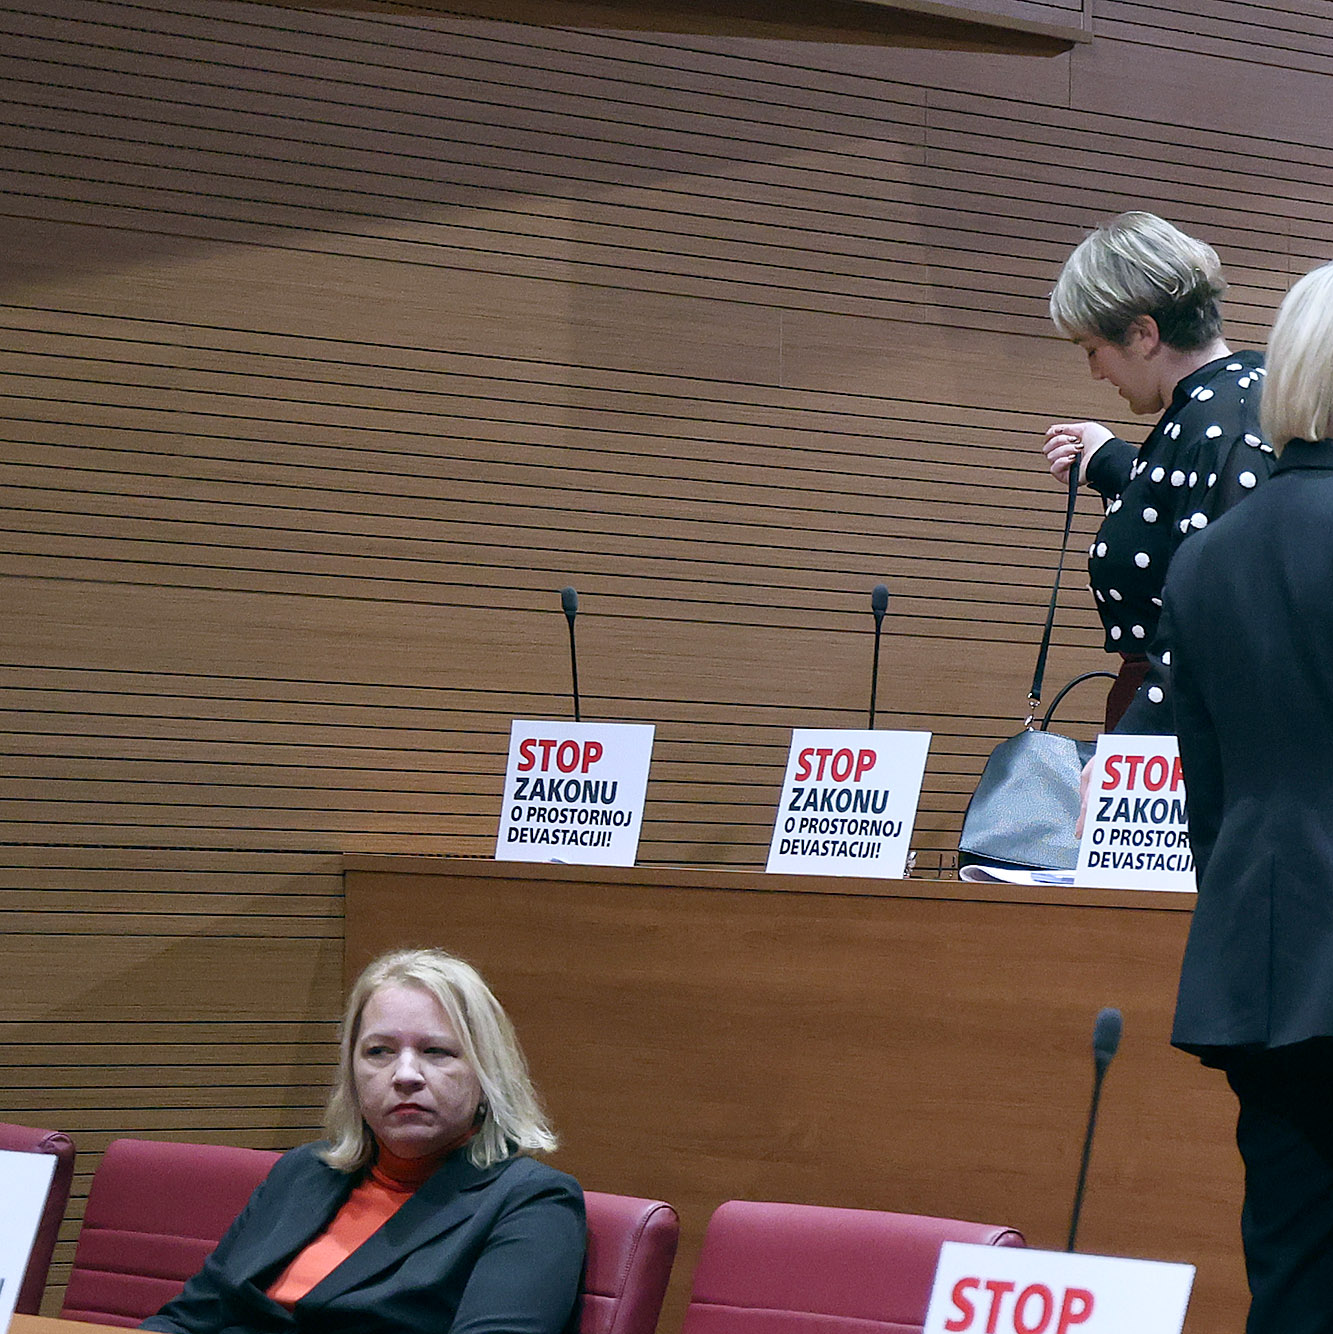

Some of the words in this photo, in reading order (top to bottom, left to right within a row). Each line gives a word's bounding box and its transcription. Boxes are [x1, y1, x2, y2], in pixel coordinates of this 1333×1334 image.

[517, 738, 603, 773] STOP
[795, 748, 877, 782] STOP
[514, 778, 618, 804] ZAKONU
[788, 788, 889, 813] ZAKONU
[511, 806, 522, 822] O
[526, 807, 632, 827] PROSTORNOJ
[1096, 797, 1188, 824] ZAKON
[507, 827, 611, 847] DEVASTACIJI!
[785, 817, 795, 833] O
[798, 818, 902, 838] PROSTORNOJ
[1093, 828, 1104, 845] O
[1110, 829, 1191, 848] PROSTOR
[779, 838, 881, 859] DEVASTACIJI!
